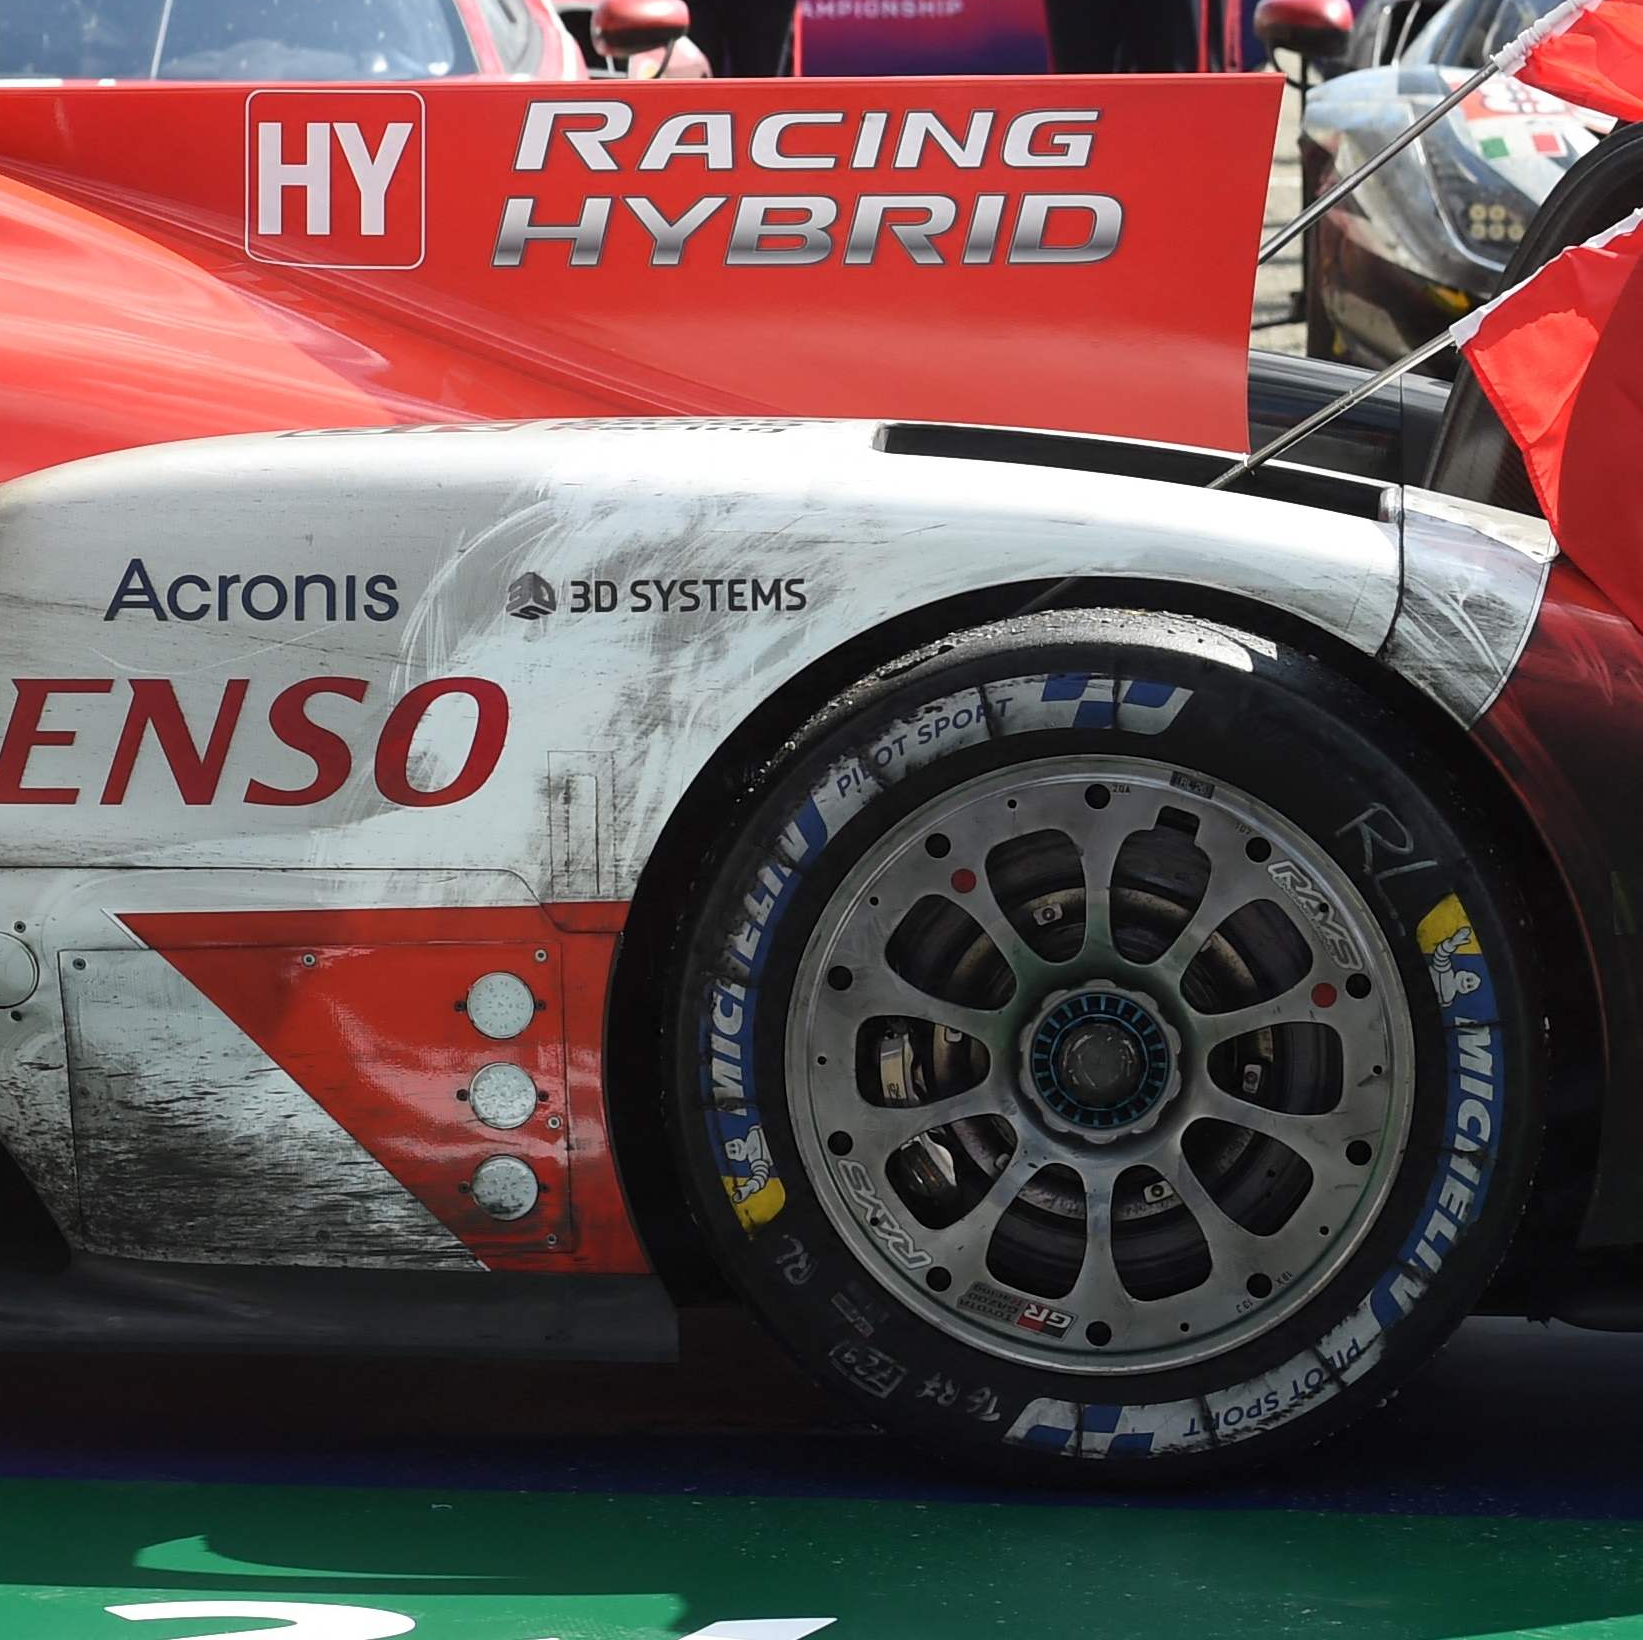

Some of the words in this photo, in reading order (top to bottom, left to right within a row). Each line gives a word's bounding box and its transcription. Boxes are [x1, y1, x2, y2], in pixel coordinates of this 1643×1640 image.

[256, 120, 415, 238] HY
[511, 99, 1103, 172] RACING
[488, 190, 1125, 269] HYBRID
[103, 557, 400, 623] Acronis
[569, 578, 624, 615] 3D
[628, 577, 808, 614] SYSTEMS
[835, 731, 908, 799] PILOT
[917, 696, 1015, 747] SPORT
[1268, 860, 1365, 972] RAYS
[837, 1159, 933, 1272] RAYS
[1182, 1389, 1280, 1438] SPORT
